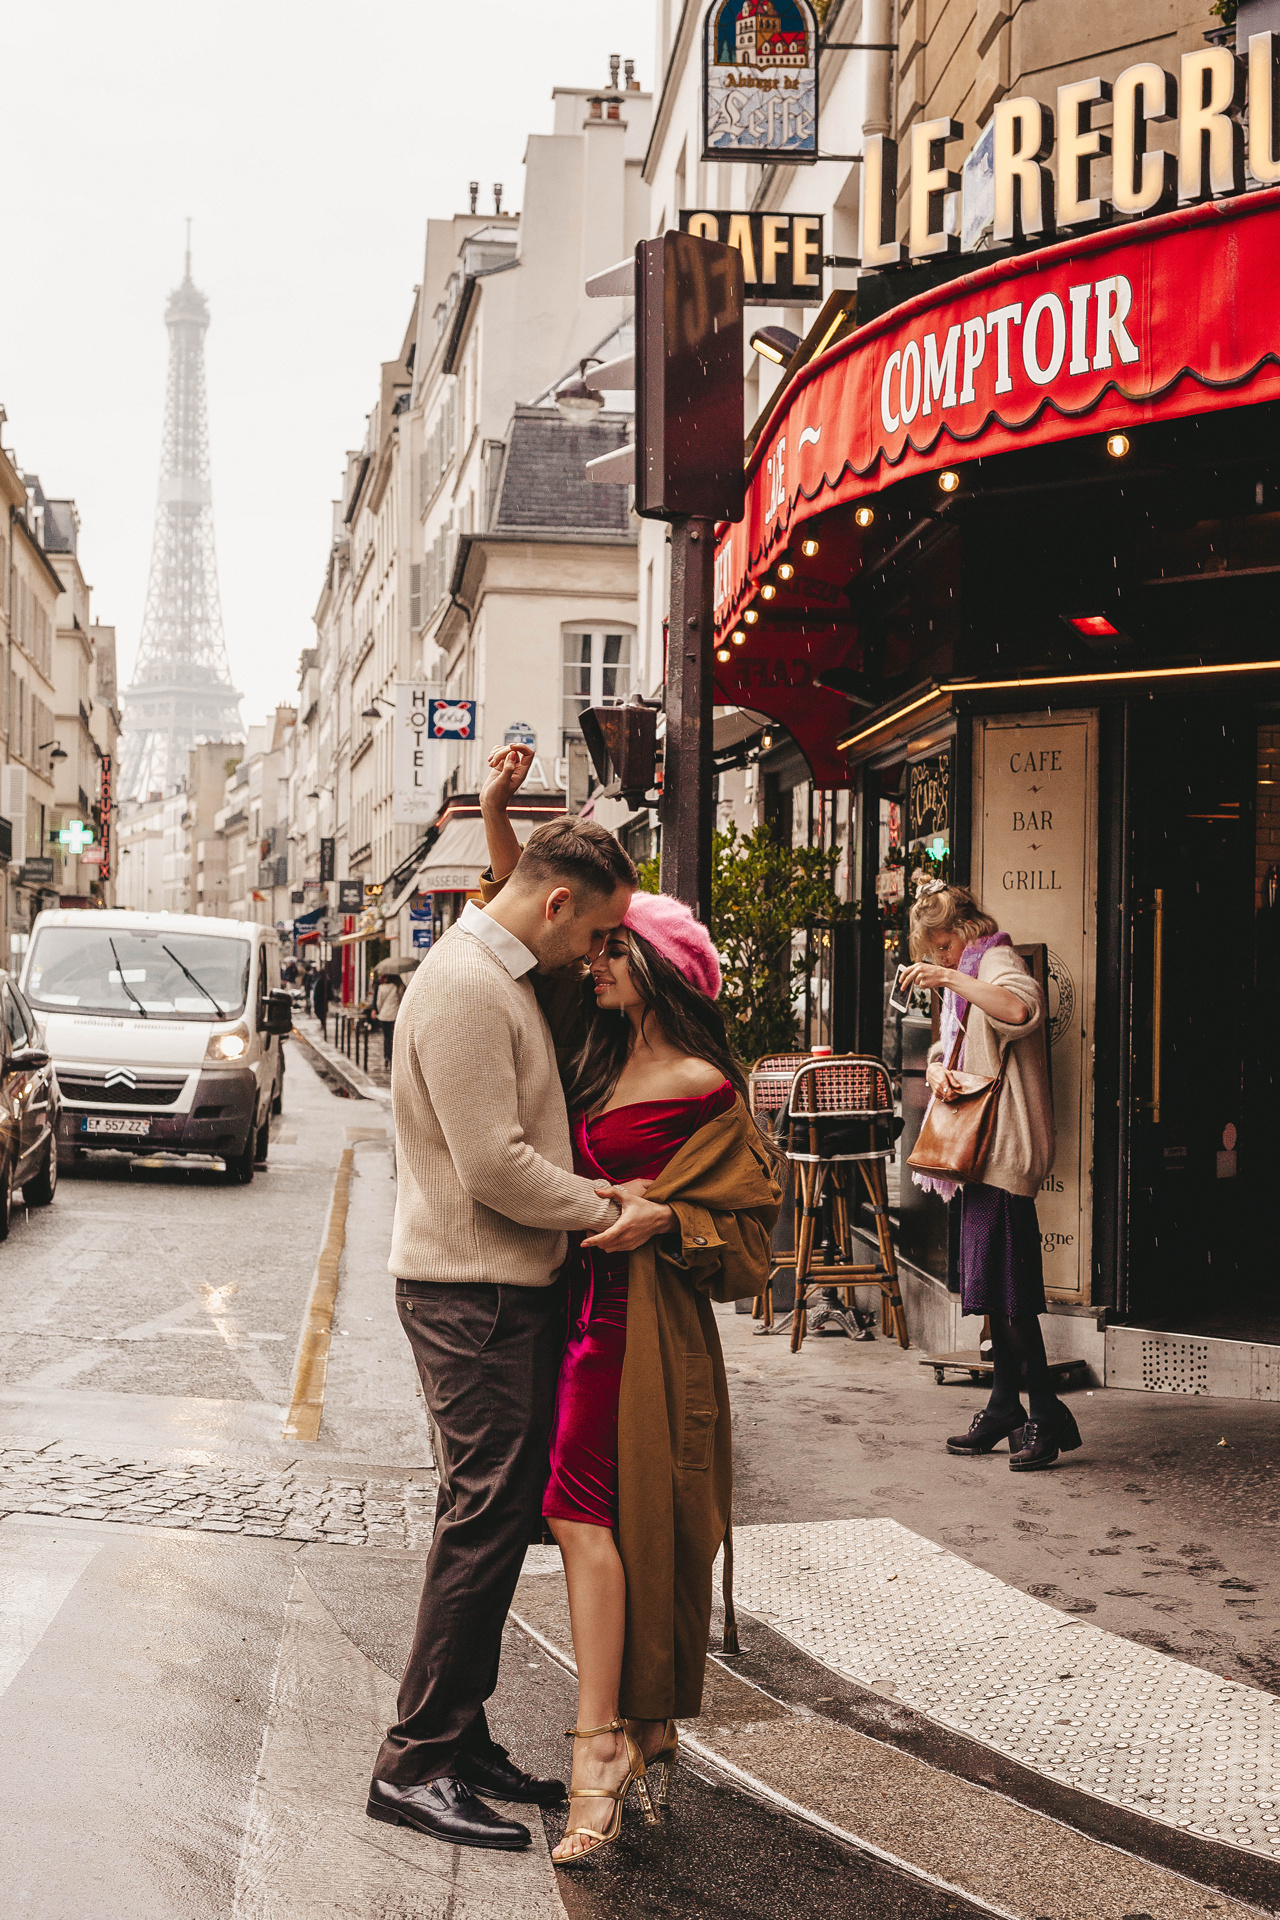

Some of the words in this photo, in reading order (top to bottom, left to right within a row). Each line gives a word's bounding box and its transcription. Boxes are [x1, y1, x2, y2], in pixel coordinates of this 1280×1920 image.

[708, 89, 816, 149] Leffe
[861, 116, 955, 268] LE
[880, 274, 1140, 433] COMPTOIR
[411, 690, 426, 787] HOTEL
[1009, 750, 1062, 773] CAFE
[1012, 810, 1053, 831] BAR
[1002, 869, 1062, 891] GRILL
